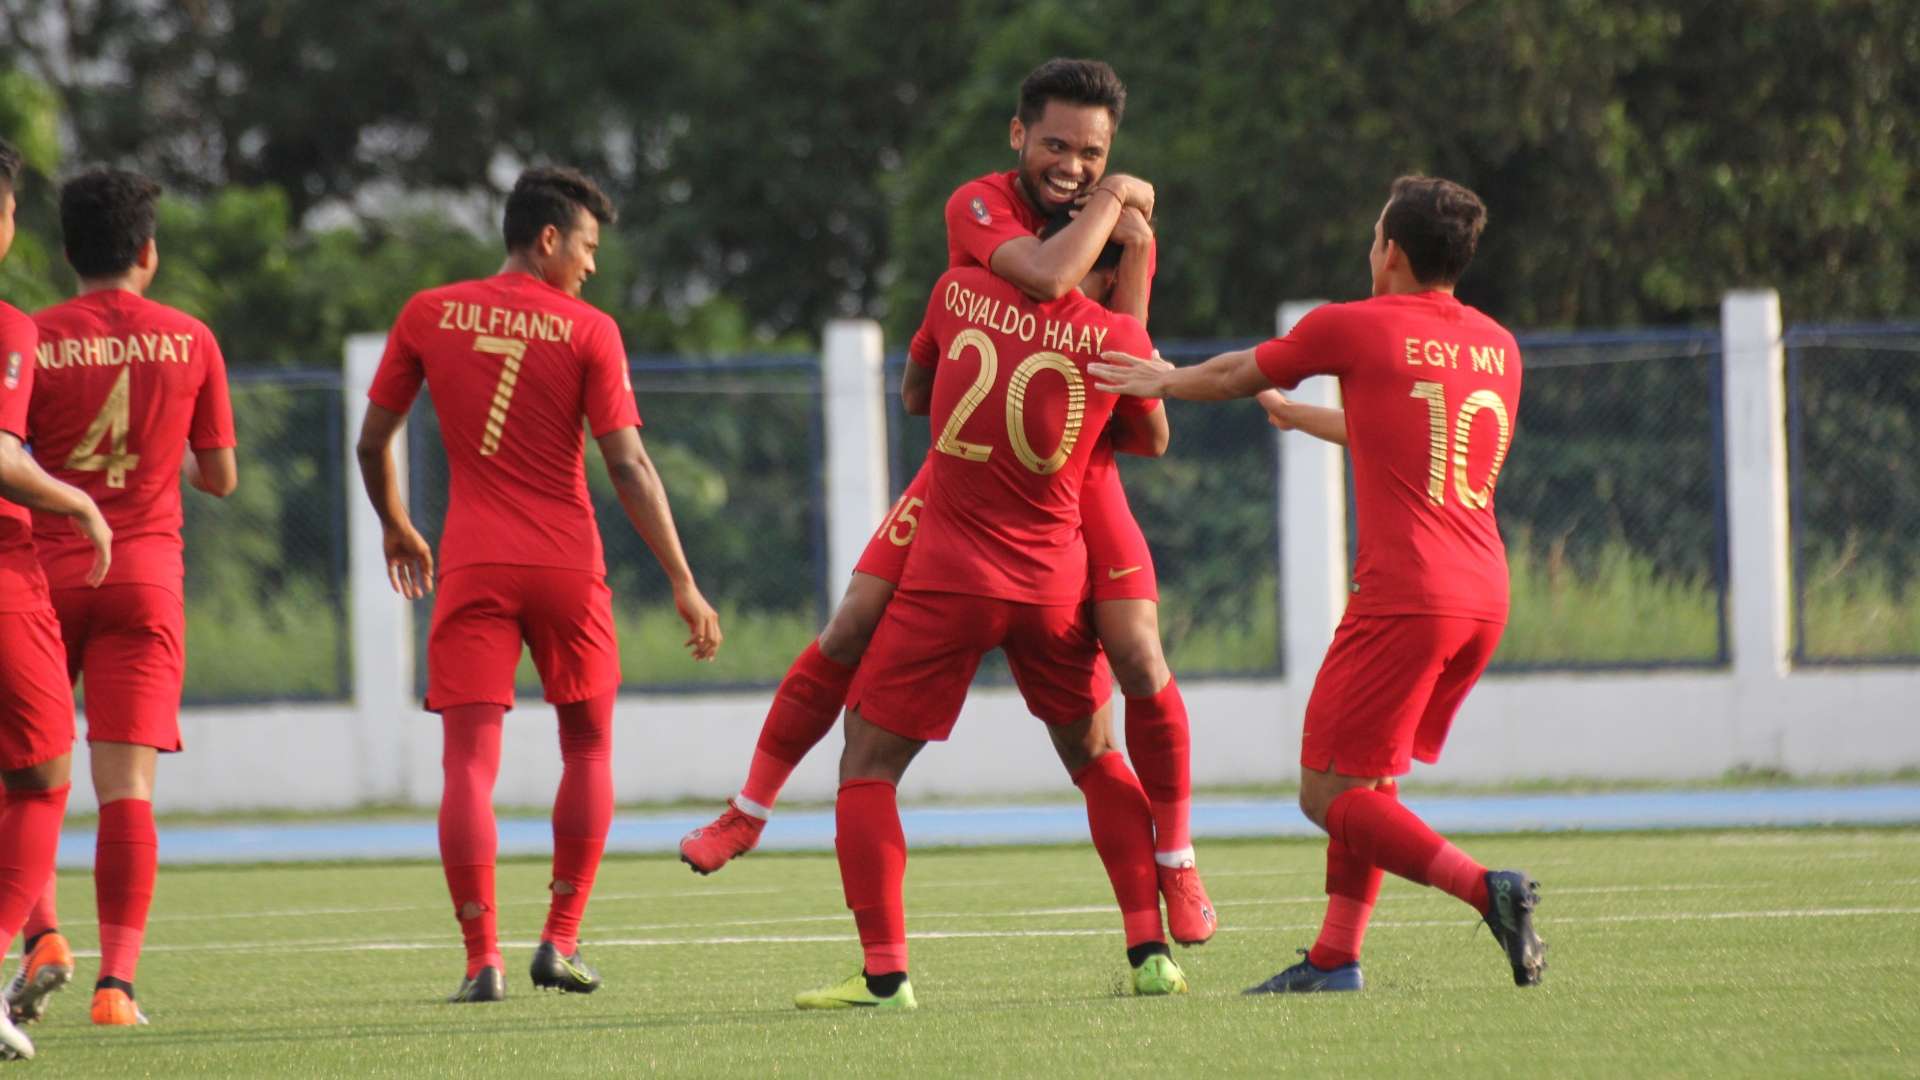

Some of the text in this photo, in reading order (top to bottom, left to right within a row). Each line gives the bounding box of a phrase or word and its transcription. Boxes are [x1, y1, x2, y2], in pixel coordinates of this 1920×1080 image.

[35, 334, 193, 369] NURHIDAYAT
[439, 301, 573, 344] ZULFIANDI
[945, 281, 1108, 355] OSVALDO HAAY
[1405, 337, 1505, 376] EGY MV
[65, 365, 140, 488] 4
[473, 335, 527, 456] 7
[935, 328, 1086, 475] 20
[1409, 381, 1509, 510] 10
[878, 495, 925, 546] 15
